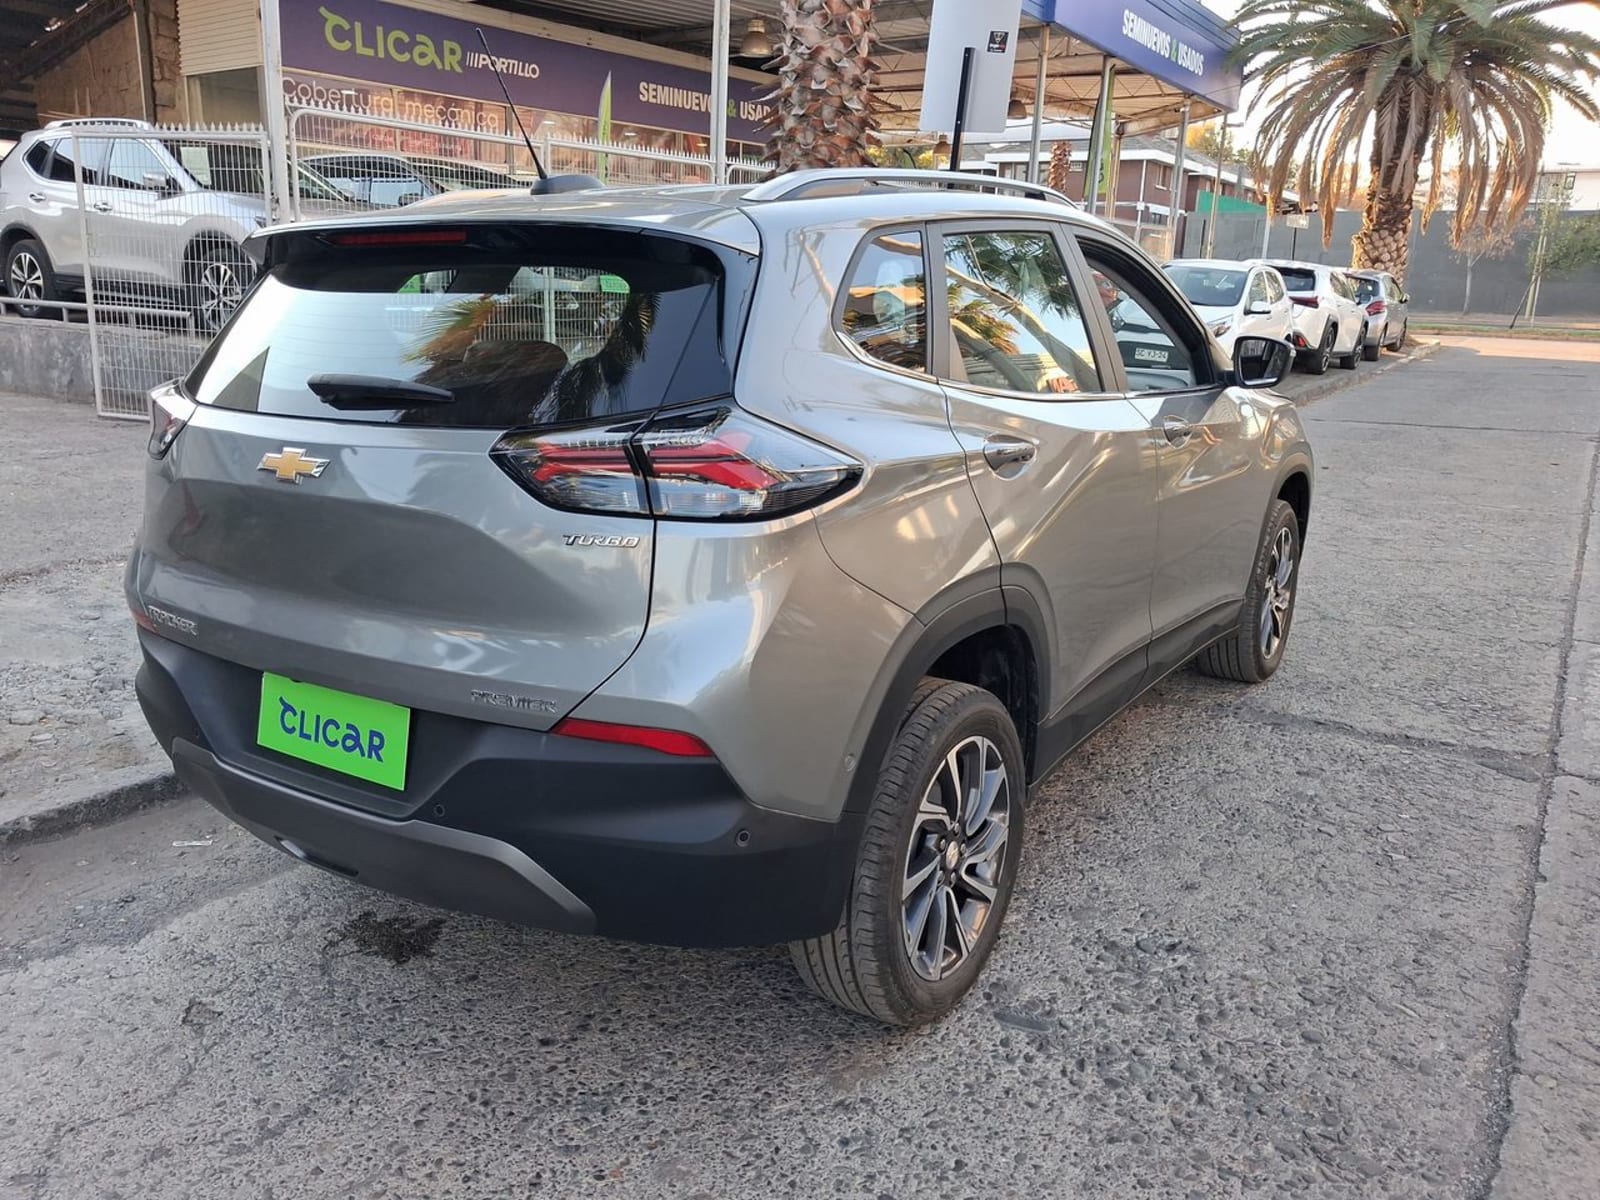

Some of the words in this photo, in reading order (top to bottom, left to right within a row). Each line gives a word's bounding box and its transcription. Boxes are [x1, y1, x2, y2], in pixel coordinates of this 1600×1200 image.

[1122, 8, 1171, 59] SEMINUEVOS
[1170, 38, 1178, 62] &
[1178, 41, 1204, 76] USADOS
[639, 81, 712, 113] SEMINUEV
[727, 98, 737, 118] &
[740, 101, 773, 123] USAD
[562, 534, 640, 549] TURBO
[470, 688, 557, 713] PREMIER
